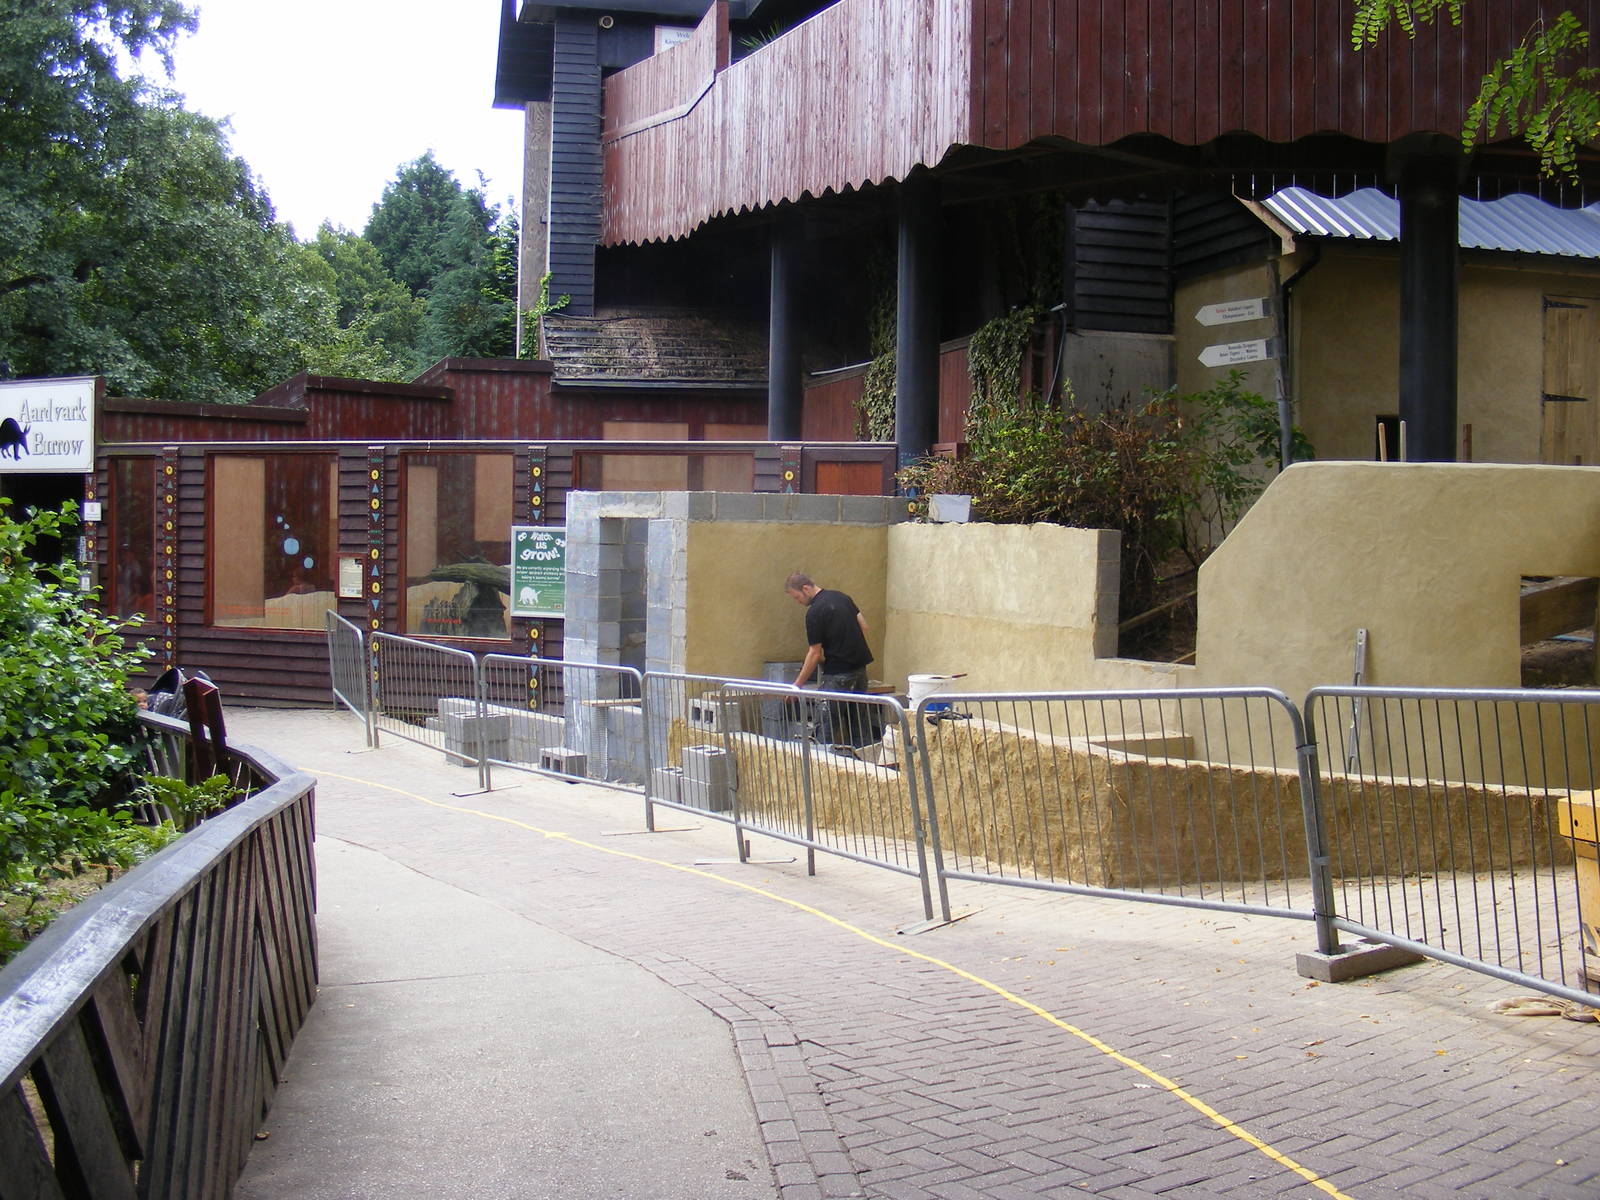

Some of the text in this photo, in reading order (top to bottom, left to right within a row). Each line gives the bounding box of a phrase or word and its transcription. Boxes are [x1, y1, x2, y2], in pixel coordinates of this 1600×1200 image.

[18, 396, 87, 423] Aardvark
[32, 432, 84, 456] Burrow
[530, 532, 553, 541] Watch
[520, 547, 560, 561] grow!
